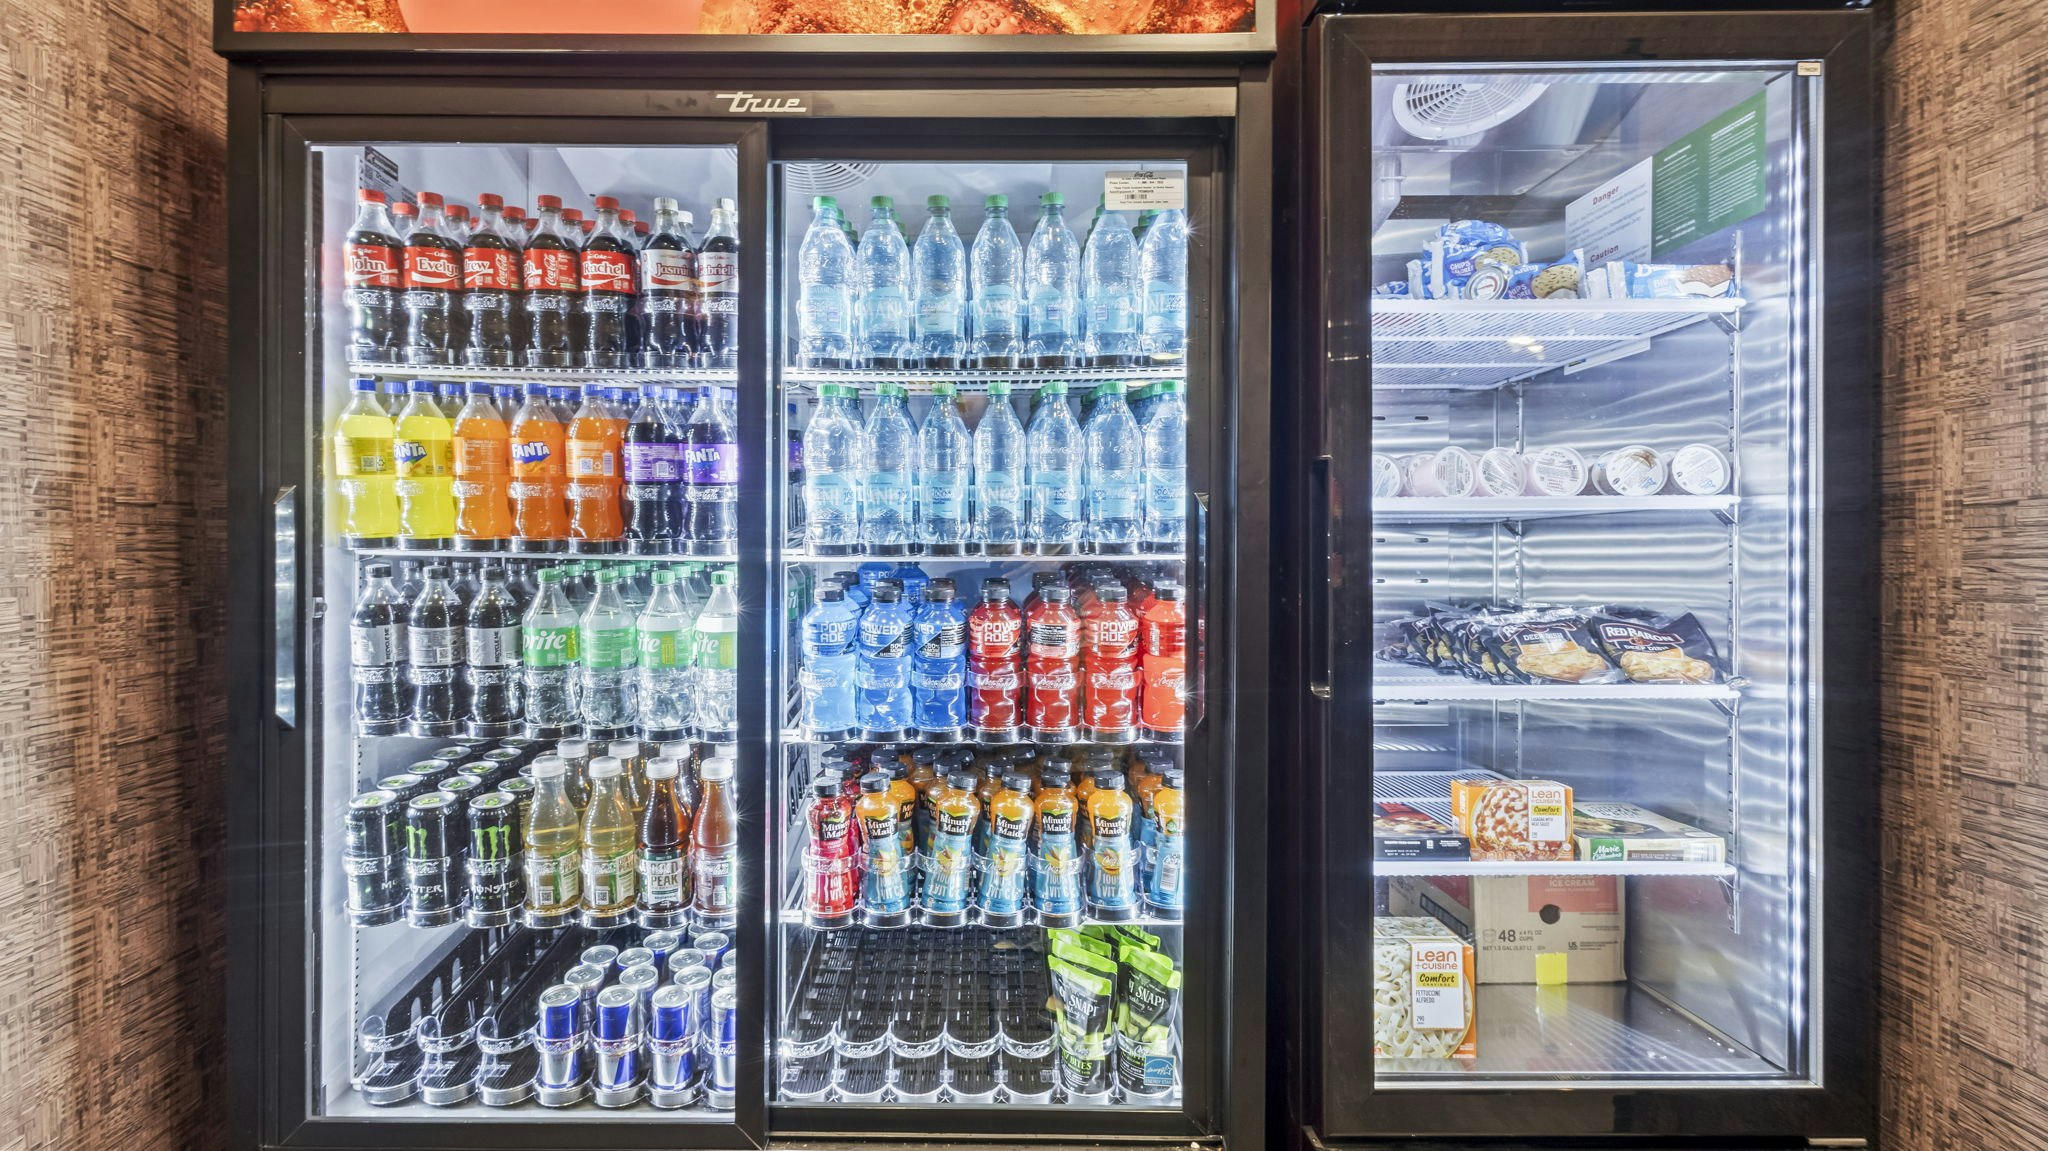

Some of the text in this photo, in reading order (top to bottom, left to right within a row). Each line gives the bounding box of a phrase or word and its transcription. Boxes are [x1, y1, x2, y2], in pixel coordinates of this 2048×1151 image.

[716, 91, 807, 112] true
[1592, 186, 1619, 206] Danger
[1590, 245, 1619, 262] Caution
[350, 256, 387, 273] John
[584, 261, 624, 277] Rachel
[511, 441, 551, 458] FANTA
[685, 448, 721, 464] FANTA
[820, 633, 845, 642] ADE
[984, 632, 1009, 642] ADE
[1101, 632, 1125, 642] ADE
[1605, 626, 1675, 642] RED BARON
[1531, 790, 1561, 799] Lean
[1533, 805, 1560, 814] Comfort
[940, 814, 972, 826] Minute
[996, 816, 1027, 831] Minute
[1042, 814, 1072, 825] Minute
[1095, 815, 1127, 828] Minute
[872, 826, 894, 837] Maid
[943, 823, 966, 834] Maid
[998, 826, 1024, 838] Maid
[1046, 823, 1068, 832] Maid
[1099, 826, 1124, 835] Maid
[1596, 845, 1620, 854] Marie
[651, 874, 679, 887] PEAK
[1565, 879, 1595, 887] CREAM
[1498, 929, 1516, 942] 48
[1416, 950, 1457, 962] Lean
[1419, 973, 1455, 983] Comfort
[1070, 1056, 1093, 1071] BITES
